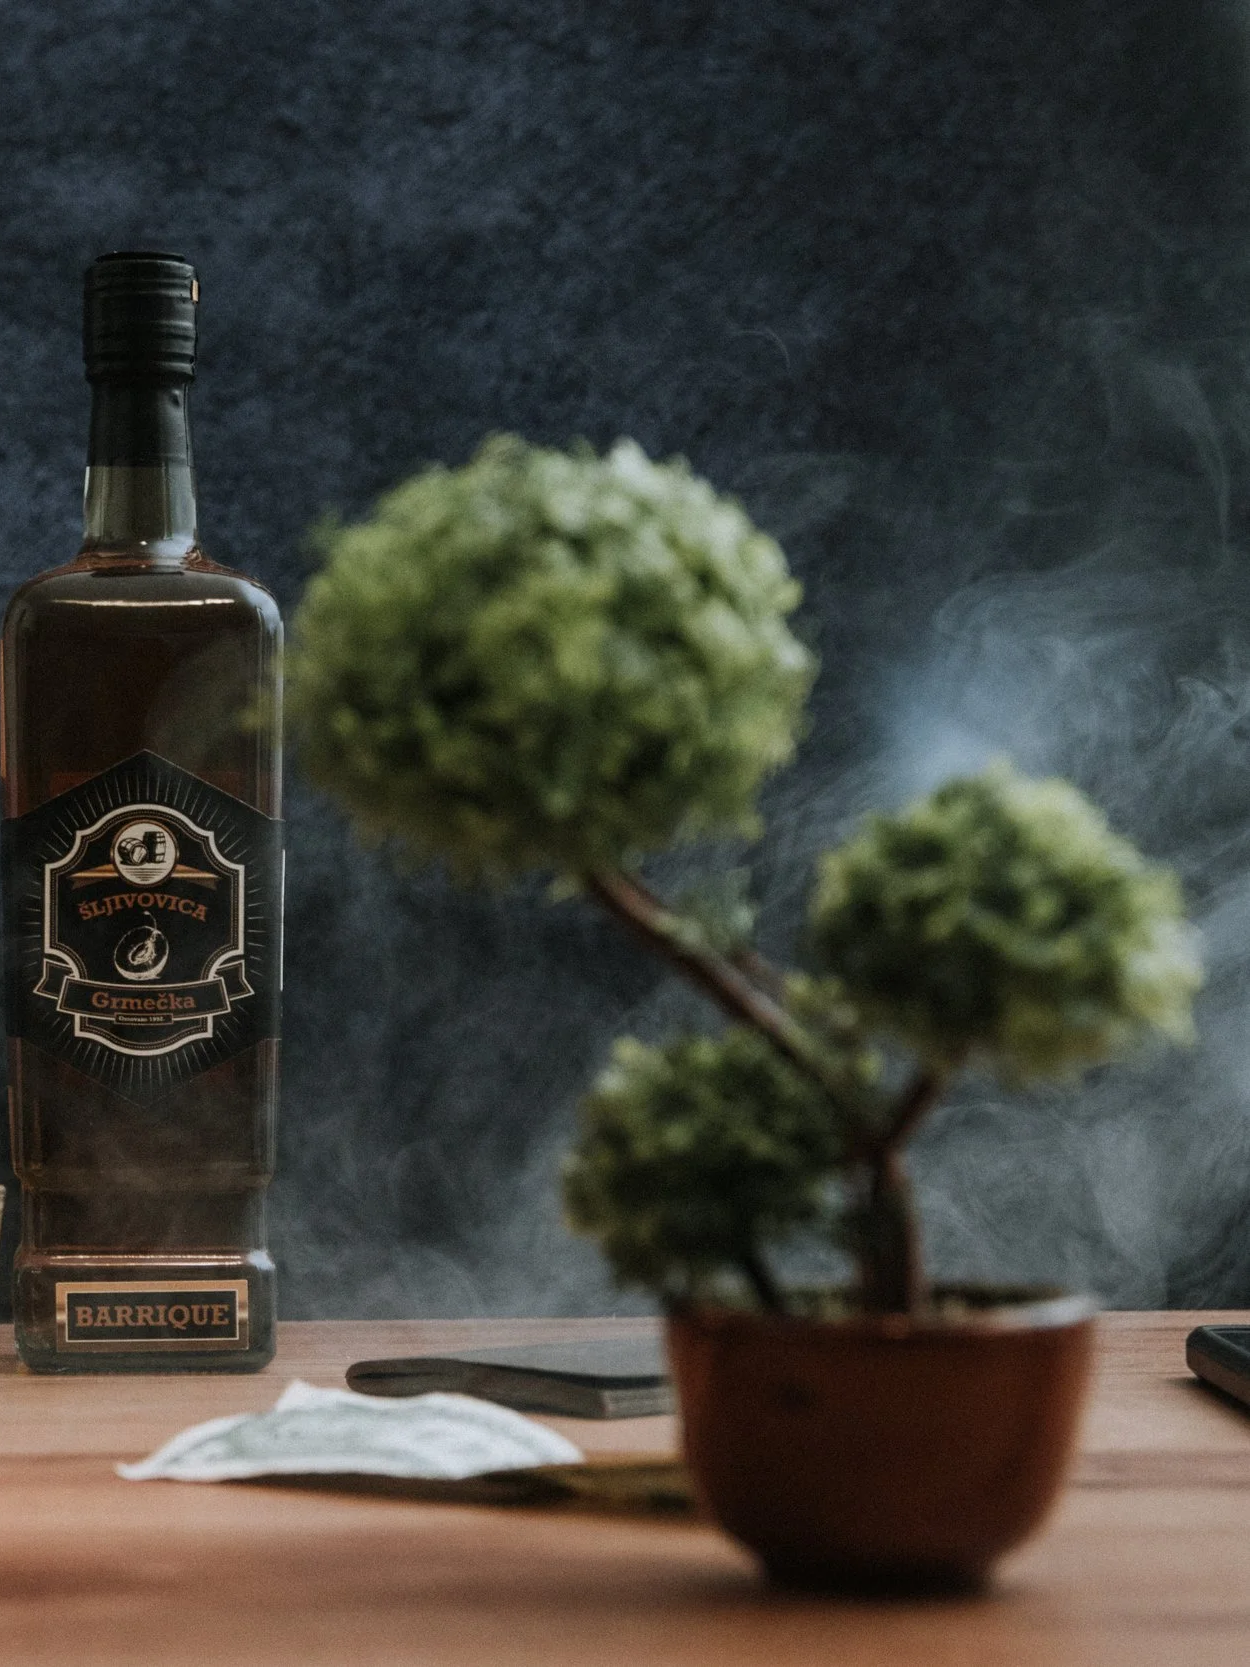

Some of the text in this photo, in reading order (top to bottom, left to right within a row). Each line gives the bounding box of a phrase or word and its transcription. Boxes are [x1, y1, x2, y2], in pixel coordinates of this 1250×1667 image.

[78, 893, 207, 922] ŠLJIVOVICA
[91, 991, 196, 1011] Grmečka
[75, 1304, 230, 1329] BARRIQUE
